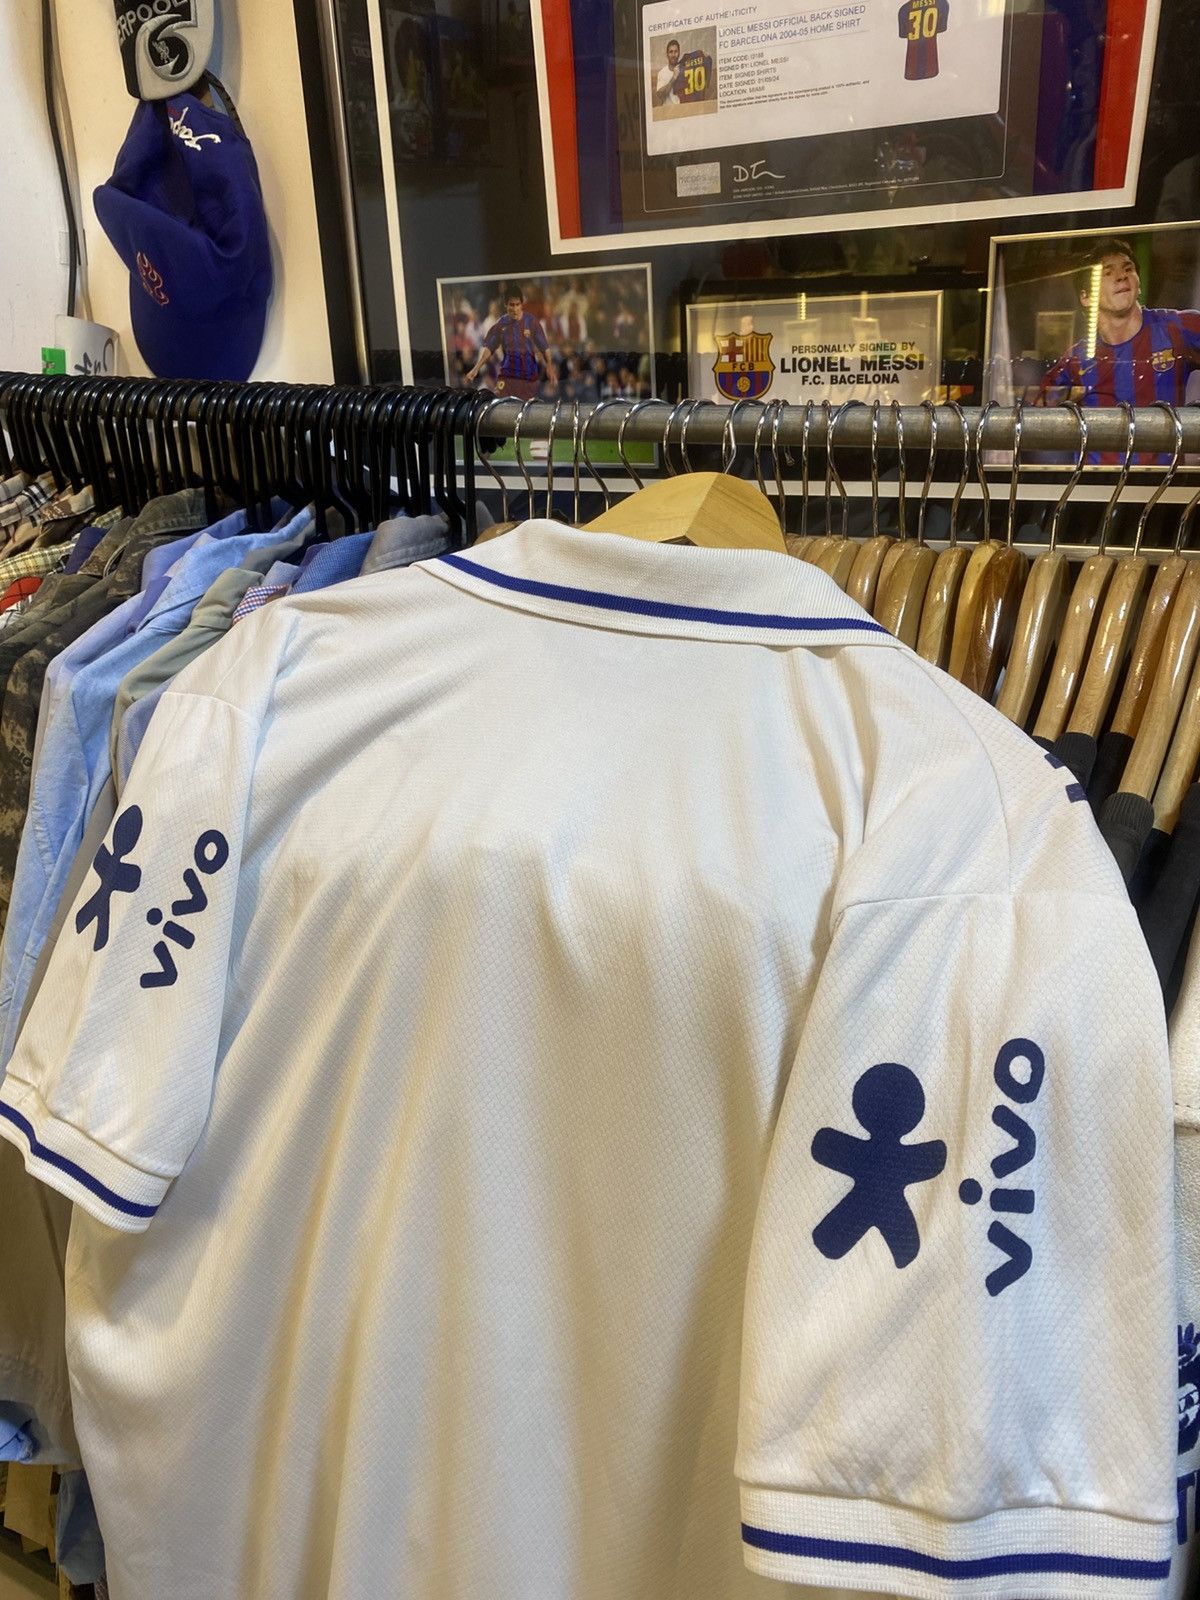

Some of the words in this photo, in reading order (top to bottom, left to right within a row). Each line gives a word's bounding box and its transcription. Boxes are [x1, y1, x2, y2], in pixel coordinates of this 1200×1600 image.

[648, 17, 692, 32] CERTIFICATE
[693, 15, 704, 24] OF
[705, 6, 758, 22] AUTHENTICITY
[718, 25, 746, 38] LIONEL
[747, 20, 772, 33] MESSI
[772, 15, 808, 29] OFFICIAL
[810, 11, 833, 23] BACK
[834, 5, 866, 19] SIGNED
[908, 7, 937, 41] 30
[718, 39, 729, 50] FC
[730, 32, 779, 49] BARCELONA
[779, 26, 809, 41] 2004-05
[810, 21, 834, 35] HOME
[835, 17, 862, 31] SHIRT
[719, 56, 732, 65] ITEM
[684, 66, 706, 95] 30
[791, 343, 856, 355] PERSONALLY
[859, 342, 897, 353] SIGNED
[901, 341, 916, 352] BY
[732, 363, 755, 372] FCB
[780, 355, 851, 374] LIONEL
[860, 354, 925, 371] MESSI
[801, 374, 825, 386] F.C.
[829, 373, 900, 386] BACELONA
[140, 829, 229, 988] vivo
[959, 1037, 1045, 1297] vivo
